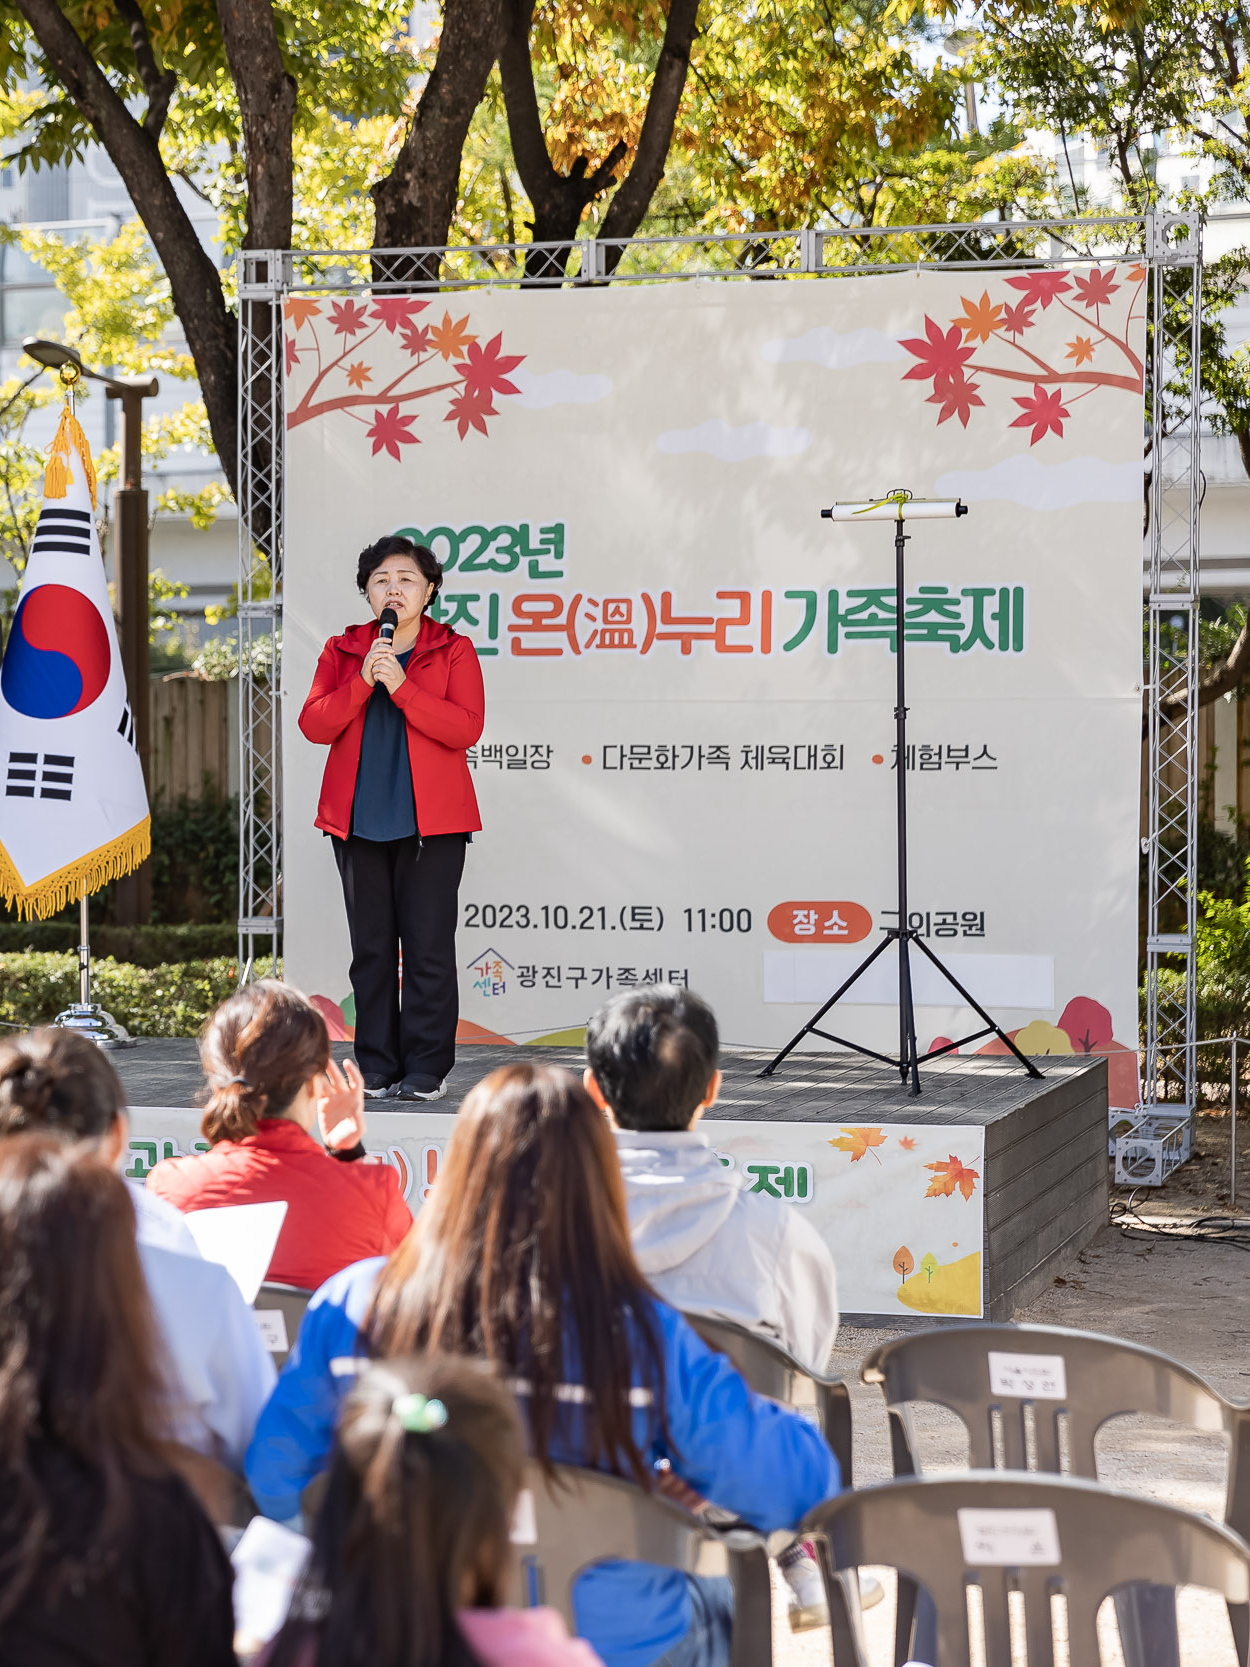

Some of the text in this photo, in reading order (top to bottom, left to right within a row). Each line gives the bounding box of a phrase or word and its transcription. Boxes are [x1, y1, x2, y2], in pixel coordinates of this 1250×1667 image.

[431, 593, 499, 656] 진
[783, 586, 1024, 654] 가족축제
[602, 744, 730, 770] 다문화가족
[740, 744, 844, 770] 체육대회
[890, 744, 997, 770] 체험부스
[464, 904, 664, 932] 2023.10.21.(토)
[683, 907, 751, 933] 11:00
